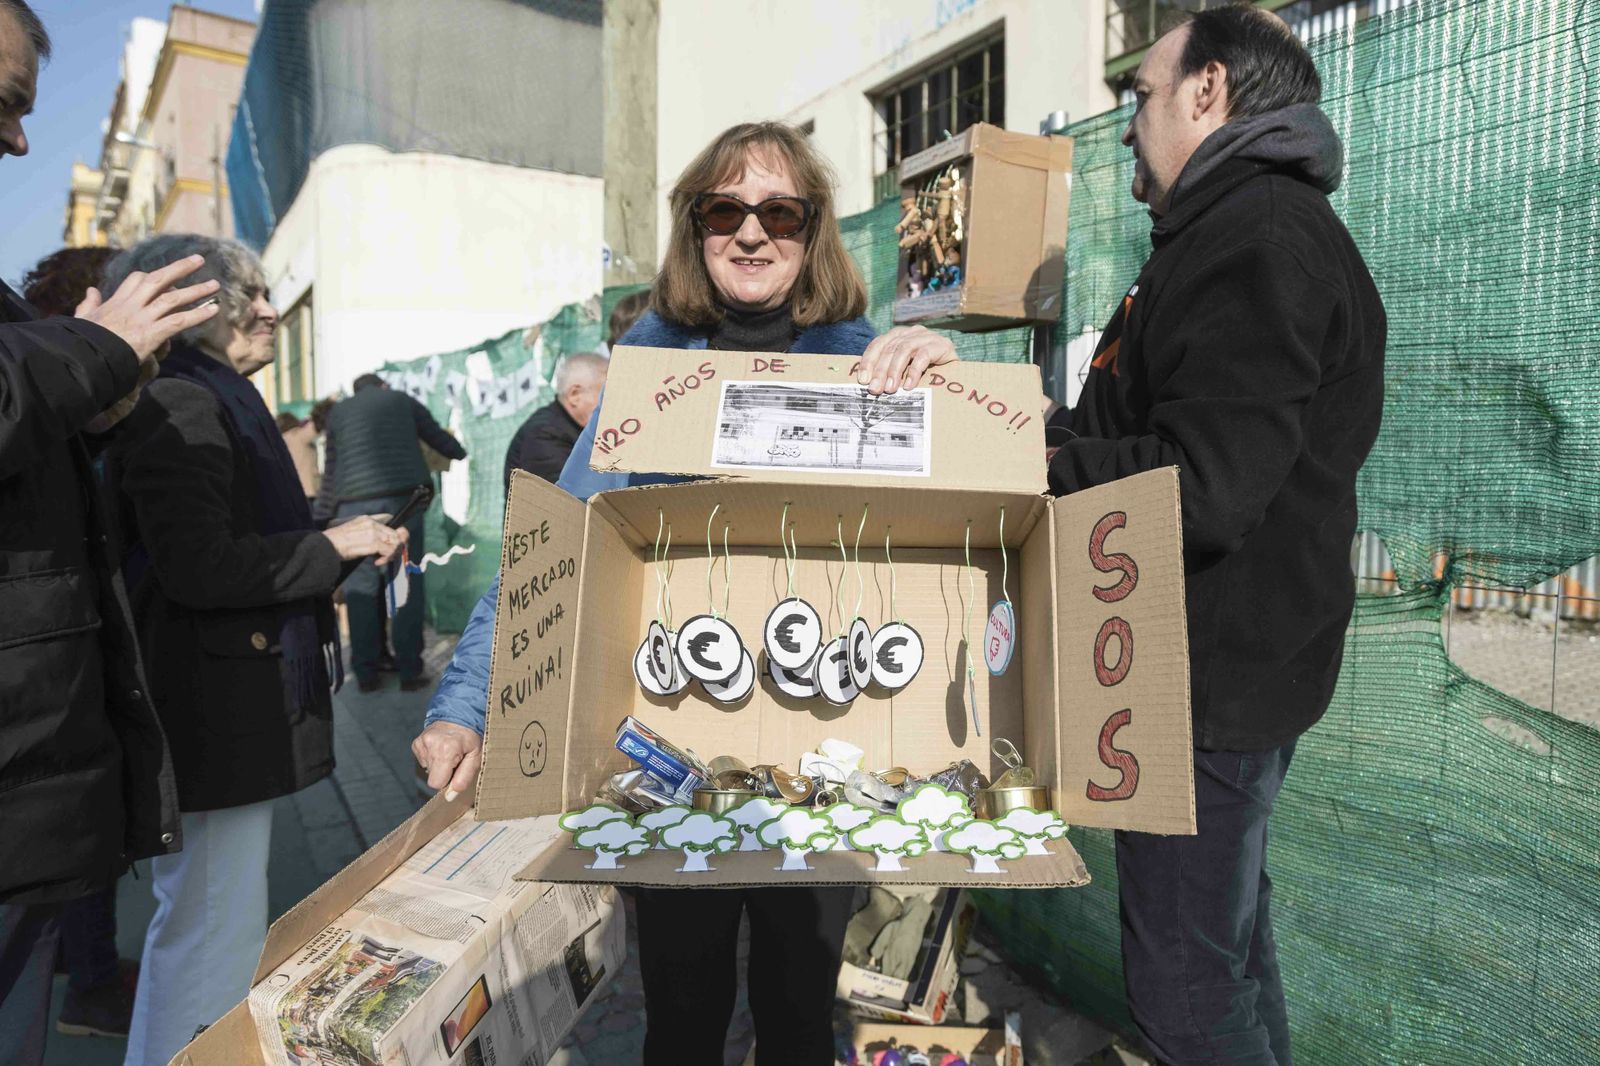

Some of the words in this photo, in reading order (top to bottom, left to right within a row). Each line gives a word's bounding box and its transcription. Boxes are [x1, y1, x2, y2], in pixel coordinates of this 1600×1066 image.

[654, 361, 716, 412] AÑOS
[751, 358, 791, 374] DE
[508, 557, 575, 621] MERCADO
[510, 628, 530, 661] ES
[537, 602, 566, 639] UNA
[1085, 510, 1140, 802] SOS
